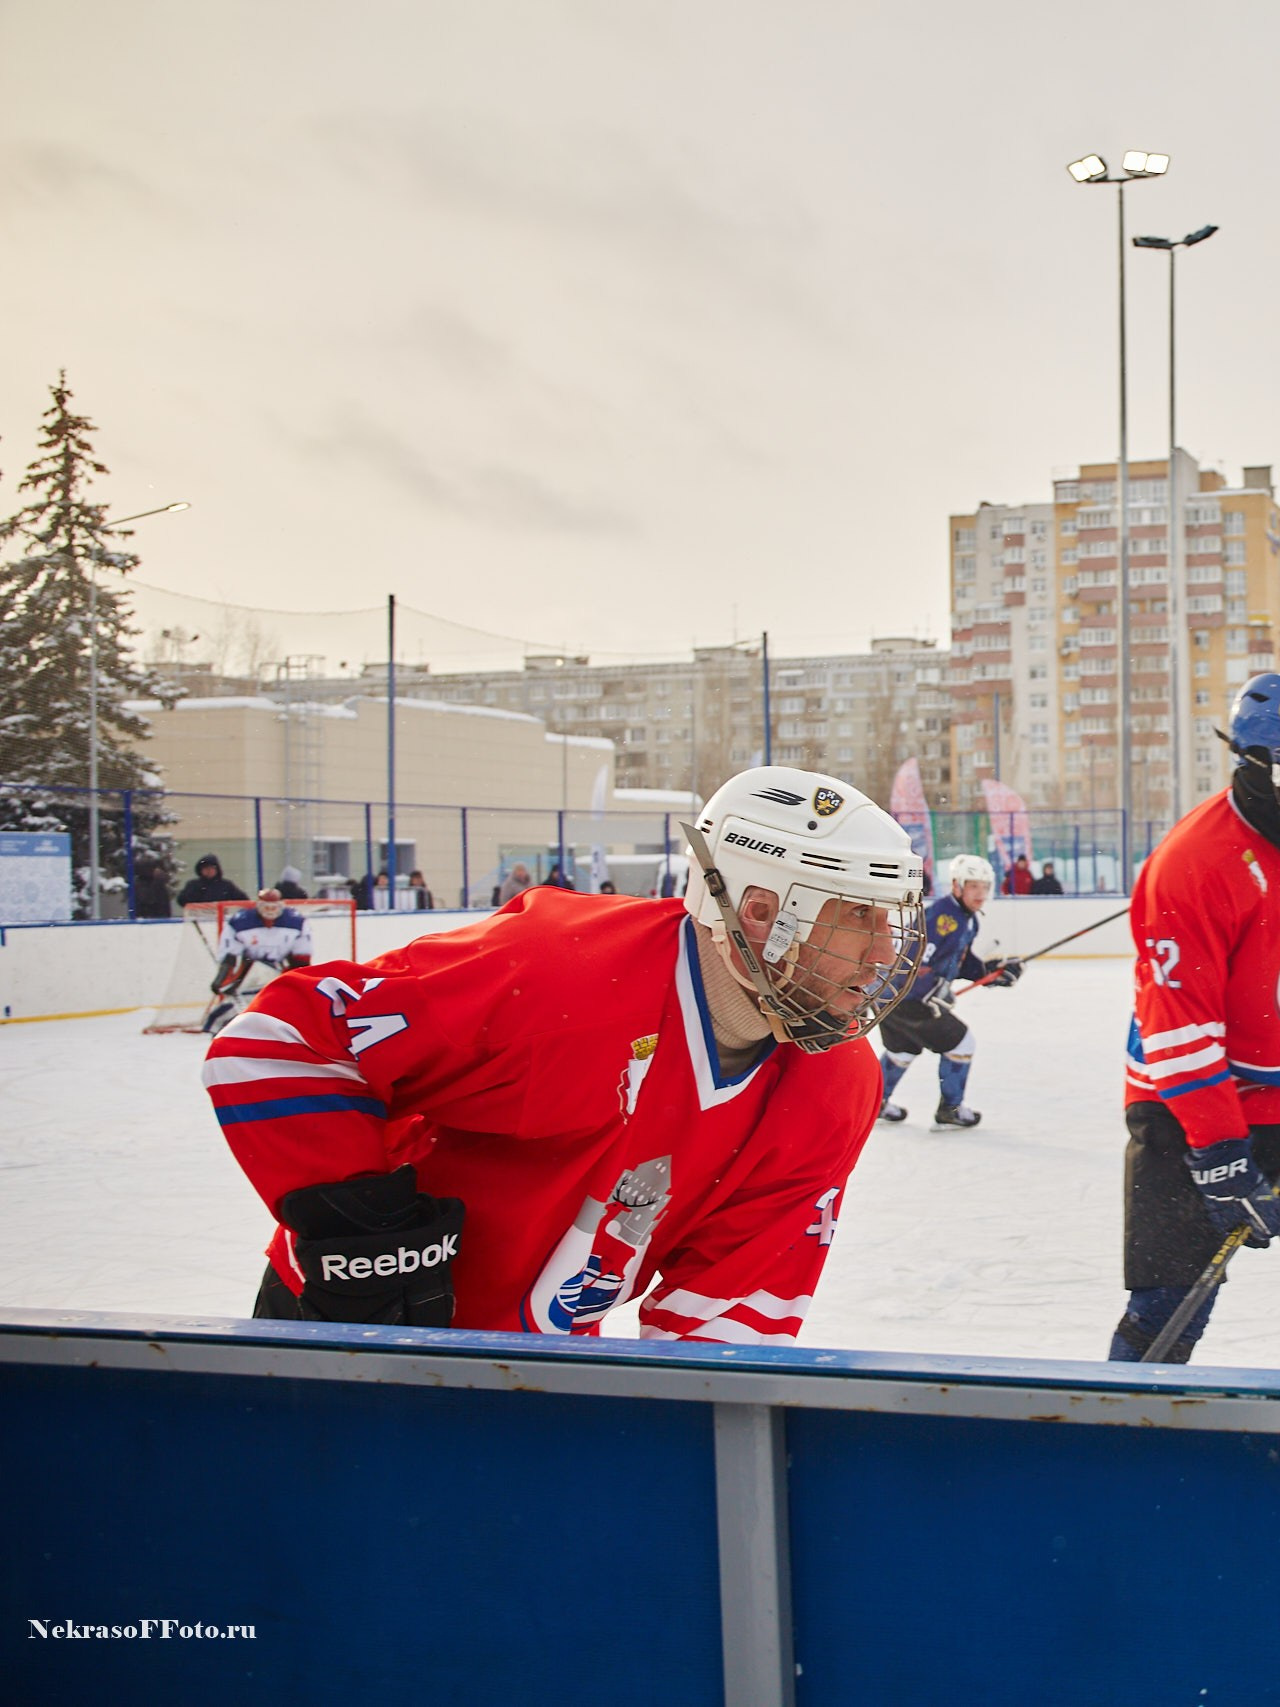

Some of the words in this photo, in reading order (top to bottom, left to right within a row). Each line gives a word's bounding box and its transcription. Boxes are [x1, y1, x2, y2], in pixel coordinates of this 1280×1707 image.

[724, 832, 787, 859] BAUER
[1190, 1158, 1249, 1185] UER
[321, 1233, 459, 1281] Reebok
